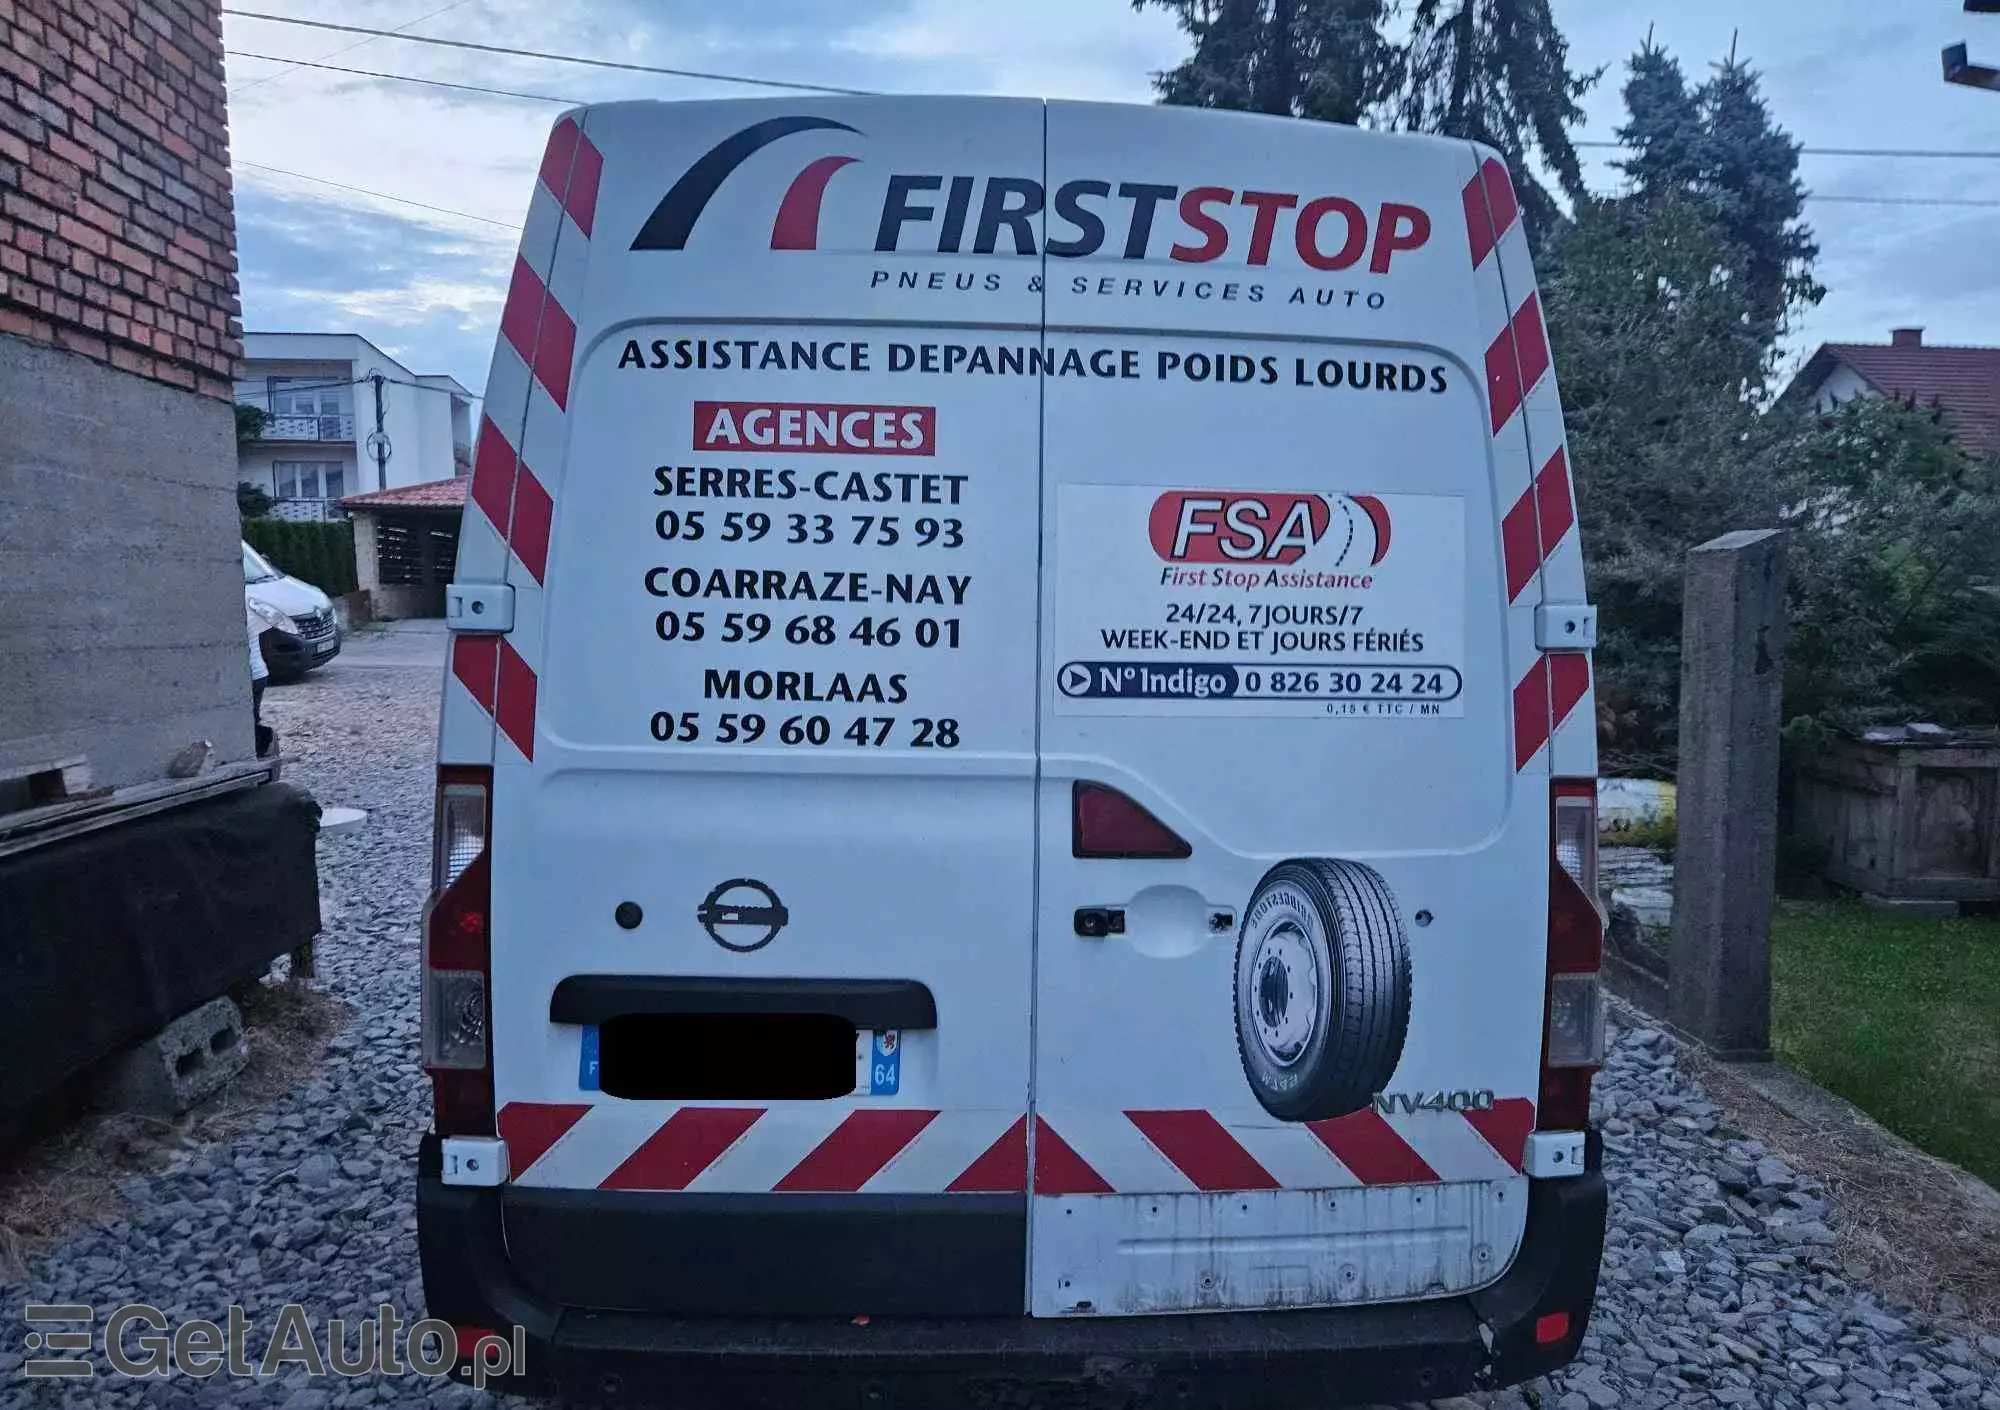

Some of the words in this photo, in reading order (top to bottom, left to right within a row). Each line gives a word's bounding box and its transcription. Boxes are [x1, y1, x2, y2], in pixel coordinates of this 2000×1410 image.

[873, 174, 1432, 274] FIRSTSTOP
[870, 270, 1002, 292] PNEUS
[1027, 275, 1045, 294] &
[1070, 275, 1266, 303] SERVICES
[1287, 287, 1385, 310] AUTO
[617, 339, 871, 371] ASSISTANCE
[888, 343, 1141, 379] DEPANNAGE
[1157, 351, 1279, 385] POIDS
[1295, 358, 1449, 394] LOURDS
[704, 407, 926, 450] AGENCES
[652, 465, 969, 505] SERRES-CASTET
[655, 511, 705, 541] 05
[720, 512, 772, 543] 59
[786, 513, 834, 545] 33
[851, 516, 900, 547] 75
[914, 518, 964, 548] 93
[1170, 493, 1318, 561] FSA
[644, 566, 973, 605] COARRAZE-NAY
[1160, 567, 1207, 587] First
[1211, 567, 1260, 592] Stop
[1264, 568, 1374, 589] Assistance
[655, 610, 705, 642] 05
[720, 612, 772, 643] 59
[784, 614, 837, 646] 68
[849, 616, 901, 648] 46
[915, 618, 962, 649] 01
[1166, 602, 1243, 628] 24/24,
[1100, 629, 1231, 651] WEEK-END
[1237, 630, 1265, 651] ET
[1270, 630, 1346, 656] JOURS
[1353, 627, 1425, 653] FÉRIÉS
[704, 669, 908, 704] MORLAAS
[1140, 667, 1228, 699] Indigo
[1245, 671, 1261, 693] 0
[1269, 671, 1320, 694] 826
[1328, 672, 1363, 694] 30
[1370, 672, 1403, 695] 24
[1411, 672, 1444, 695] 24
[1377, 703, 1403, 715] TTC
[1420, 703, 1441, 715] MN
[649, 711, 700, 743] 05
[715, 713, 767, 744] 59
[779, 715, 831, 746] 60
[843, 717, 896, 748] 47
[909, 717, 961, 748] 28
[874, 1063, 896, 1086] 64
[1369, 1087, 1495, 1114] NV400
